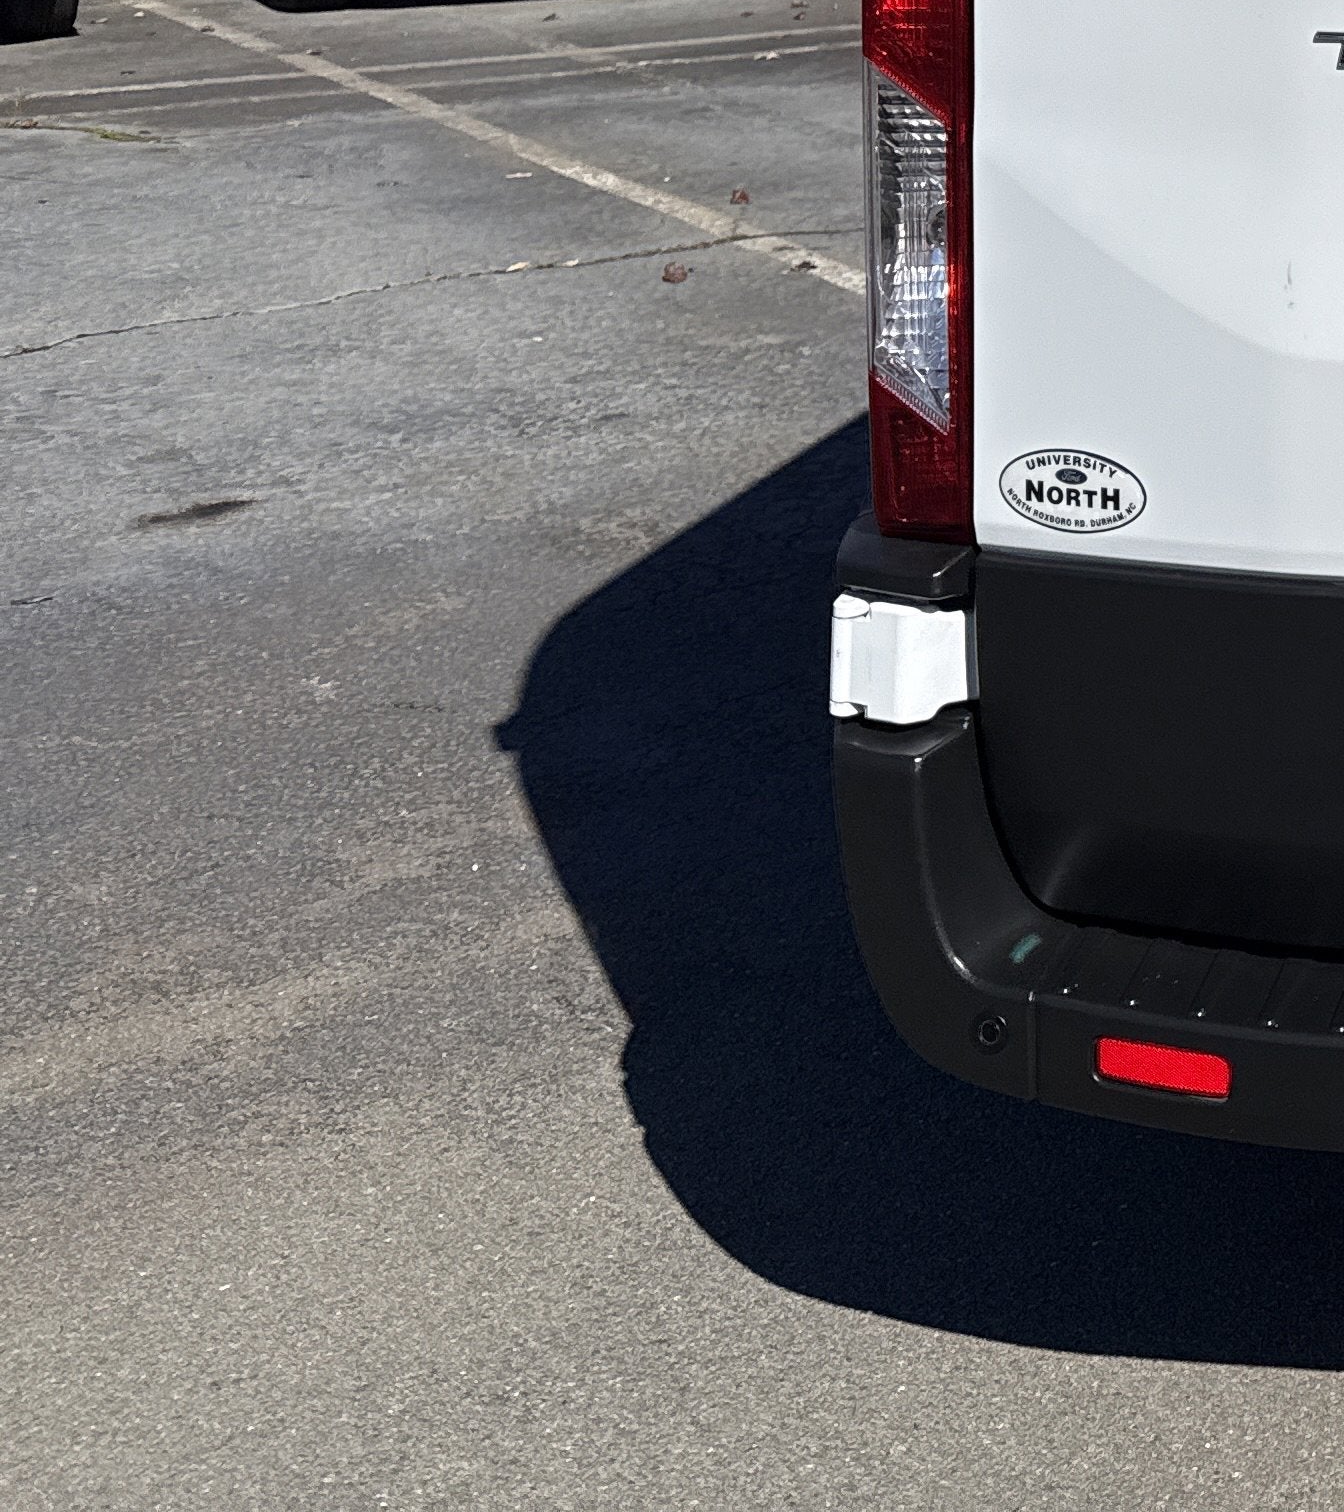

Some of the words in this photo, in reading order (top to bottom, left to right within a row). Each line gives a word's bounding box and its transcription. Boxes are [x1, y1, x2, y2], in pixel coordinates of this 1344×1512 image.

[1025, 454, 1117, 479] UNIVERSITY
[1006, 487, 1033, 513] NORTH
[1033, 508, 1072, 527] ROXBORO
[1125, 502, 1137, 515] NC
[1025, 479, 1120, 511] NORTH
